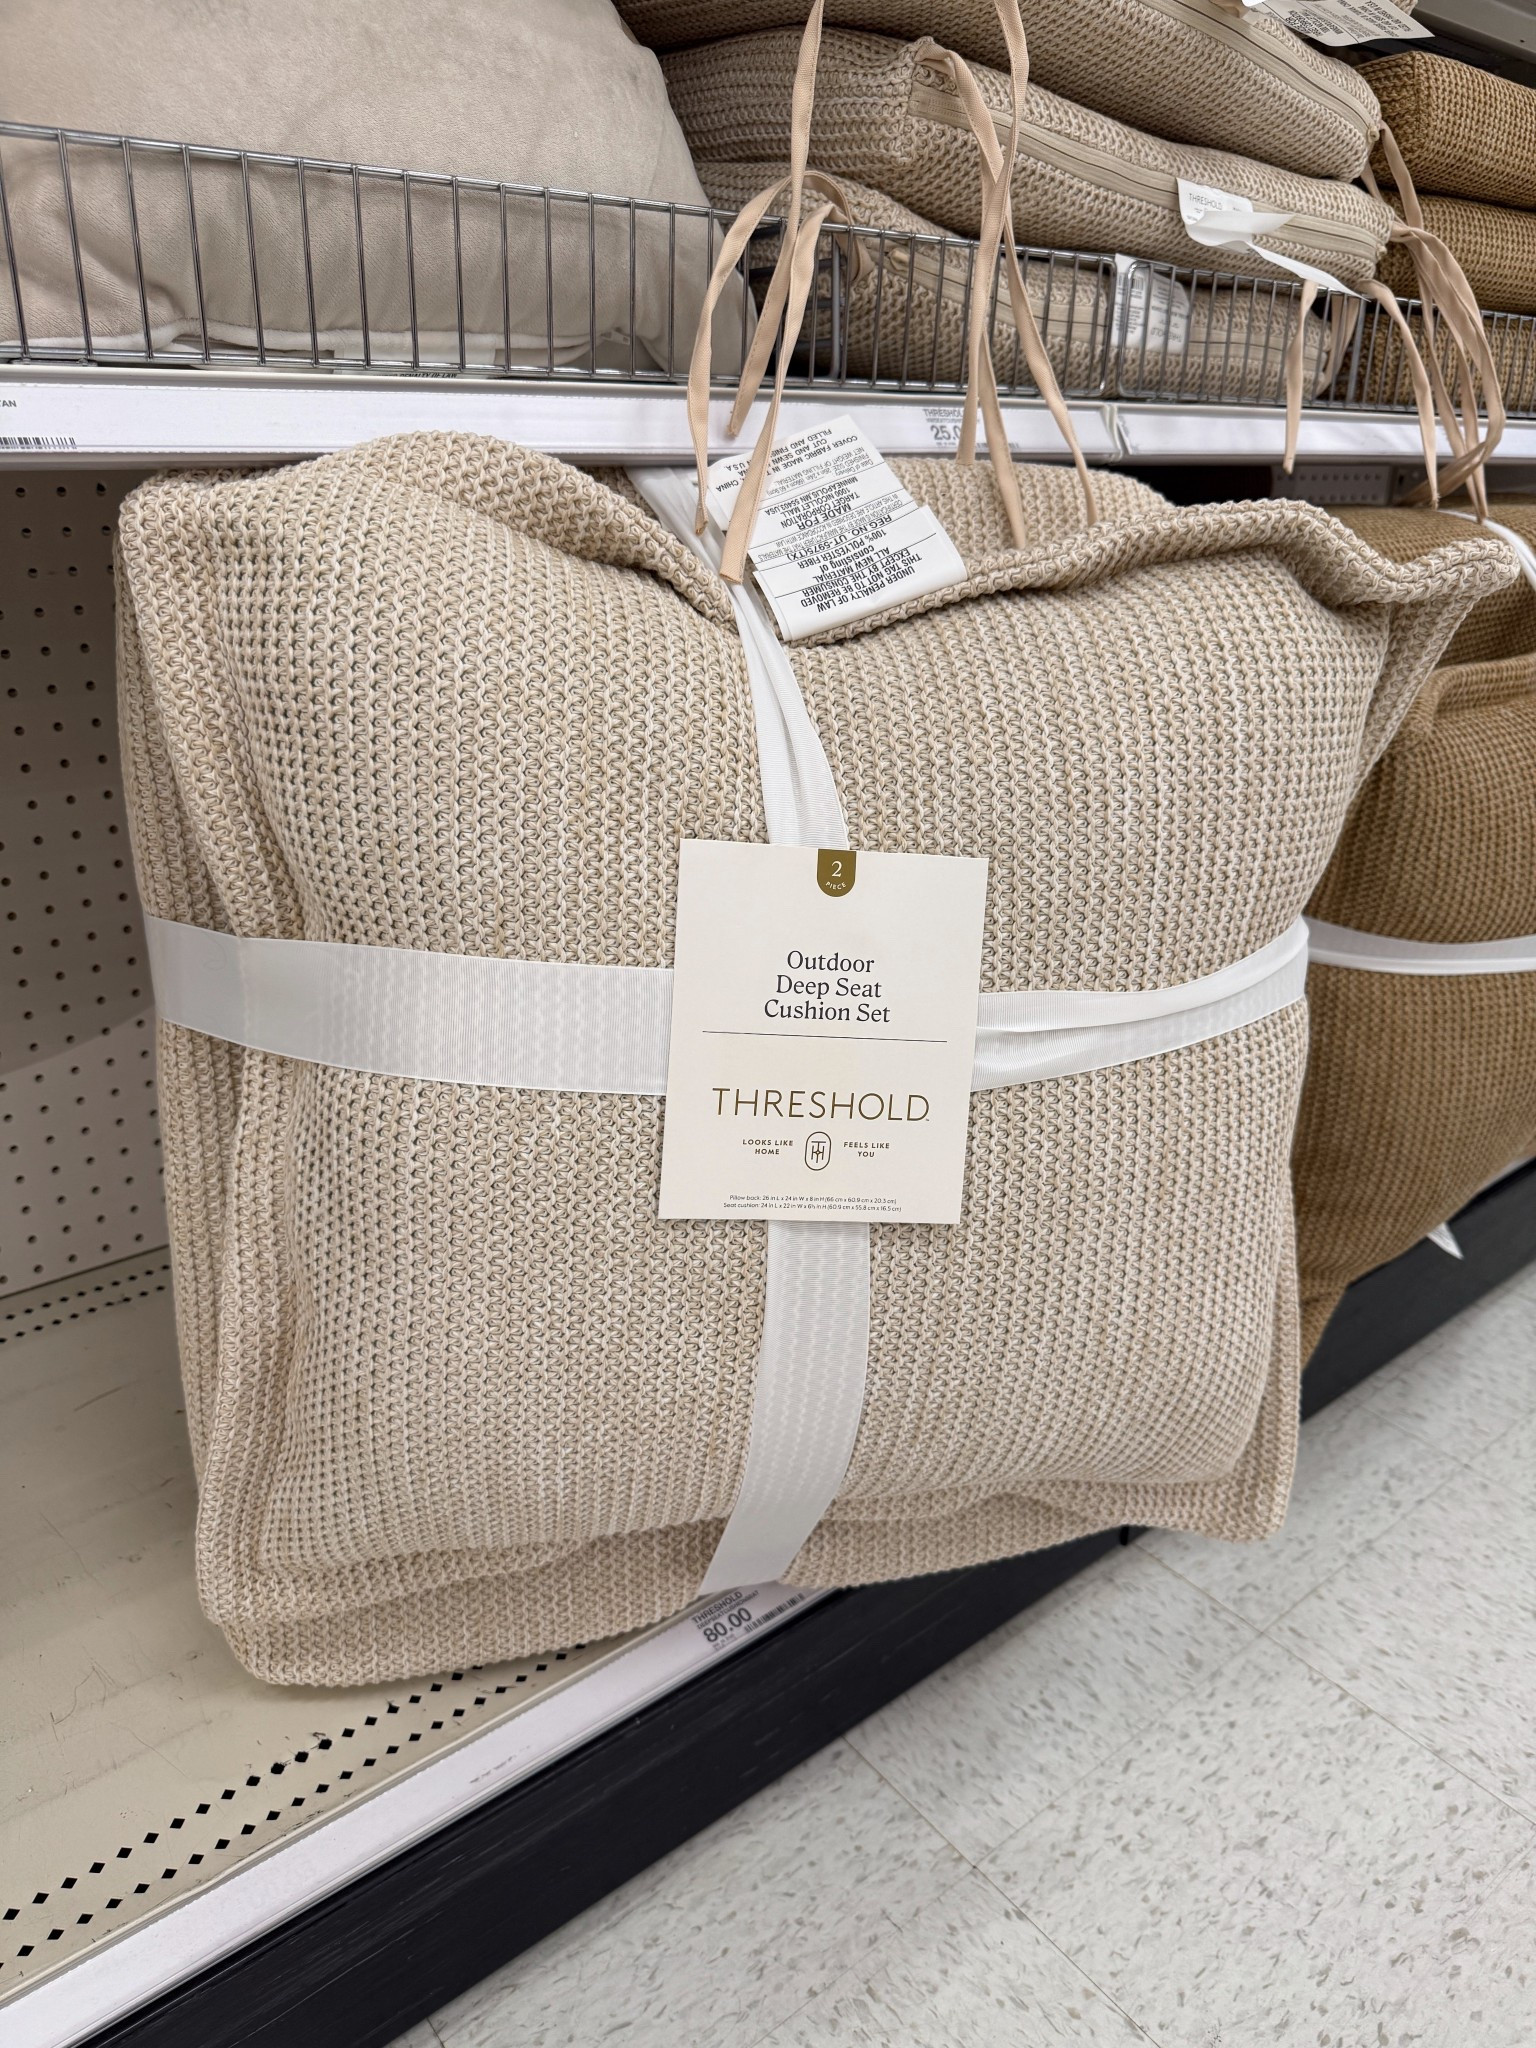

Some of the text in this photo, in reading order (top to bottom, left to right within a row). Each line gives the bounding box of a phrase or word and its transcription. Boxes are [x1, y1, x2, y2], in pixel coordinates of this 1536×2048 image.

[788, 438, 805, 449] AND
[805, 427, 832, 441] FILLED
[810, 437, 827, 448] CUT
[830, 434, 857, 448] COVER
[770, 452, 793, 464] SEWN
[793, 445, 810, 455] AND
[803, 444, 831, 460] FABRIC
[780, 457, 803, 469] MADE
[778, 490, 860, 528] TARGET CORPORATION
[779, 486, 850, 518] 1000 NICOLLET MALL
[795, 503, 851, 530] MADE FOR
[796, 527, 886, 569] 100% POLYESTER FIBER
[818, 544, 875, 573] consisting of
[800, 547, 910, 597] EXCEPT BY THE CONSUMER
[811, 547, 890, 584] ALL NEW MATERIAL
[799, 552, 921, 607] THIS TAG NOT TO BE REMOVED
[814, 565, 915, 612] UNDER PENALTY OF LAW
[831, 860, 842, 877] 2
[825, 881, 847, 890] PIECE
[787, 950, 875, 973] Outdoor
[776, 974, 882, 999] Deep Seat
[764, 999, 891, 1023] Cushion Set
[712, 1087, 930, 1121] THRESHOLD
[775, 1139, 794, 1147] LIKE
[843, 1141, 869, 1149] FEELS
[692, 1591, 743, 1624] THRESHOLD
[703, 1607, 752, 1642] 80.00
